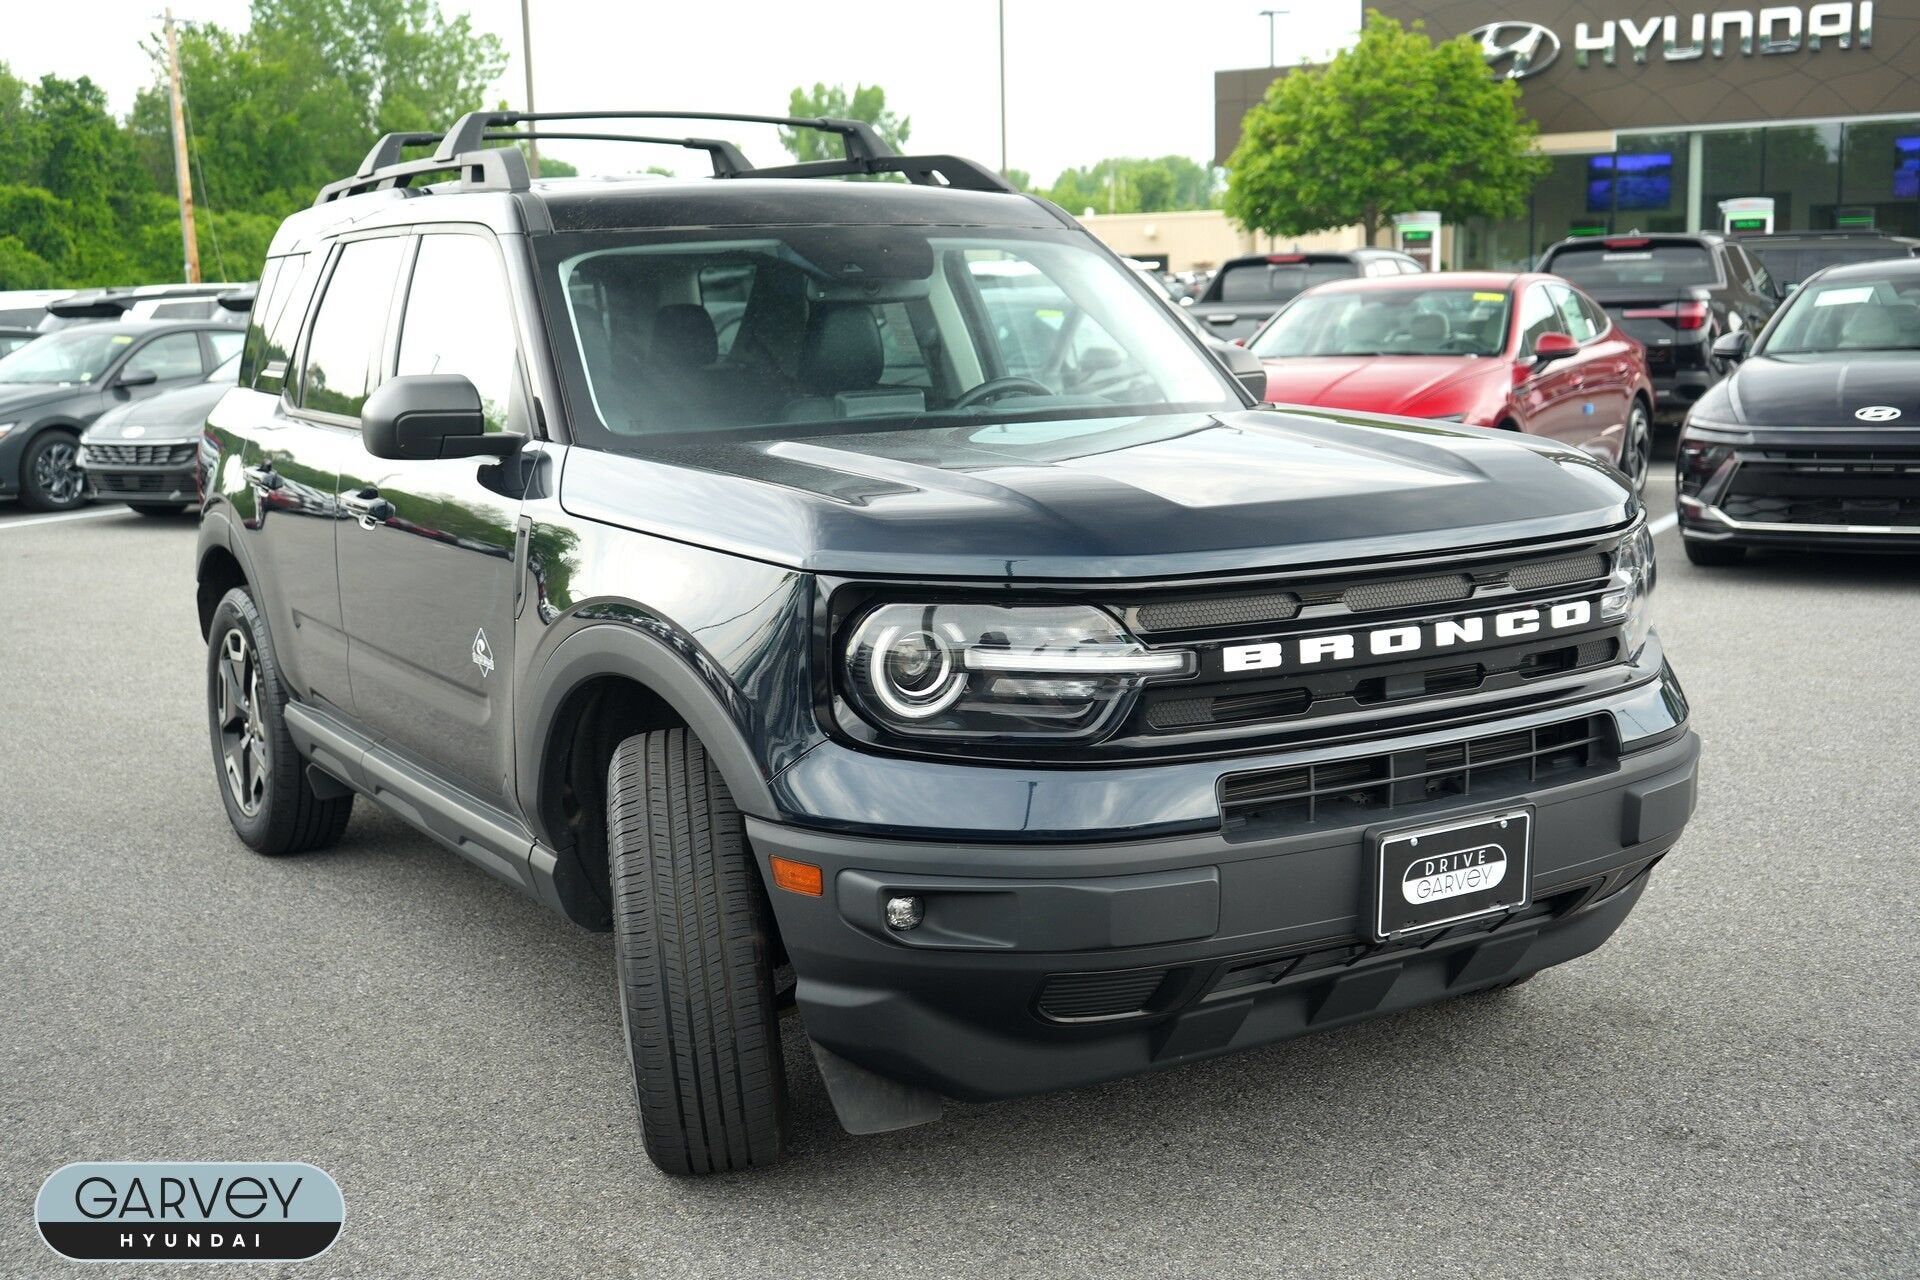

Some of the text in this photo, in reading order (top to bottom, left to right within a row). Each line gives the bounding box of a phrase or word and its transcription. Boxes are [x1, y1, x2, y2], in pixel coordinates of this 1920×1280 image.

[1575, 1, 1873, 68] HYUNDAI
[1223, 600, 1591, 672] BRONCO
[1416, 865, 1493, 899] GARVEY
[1425, 850, 1486, 876] DRIVE
